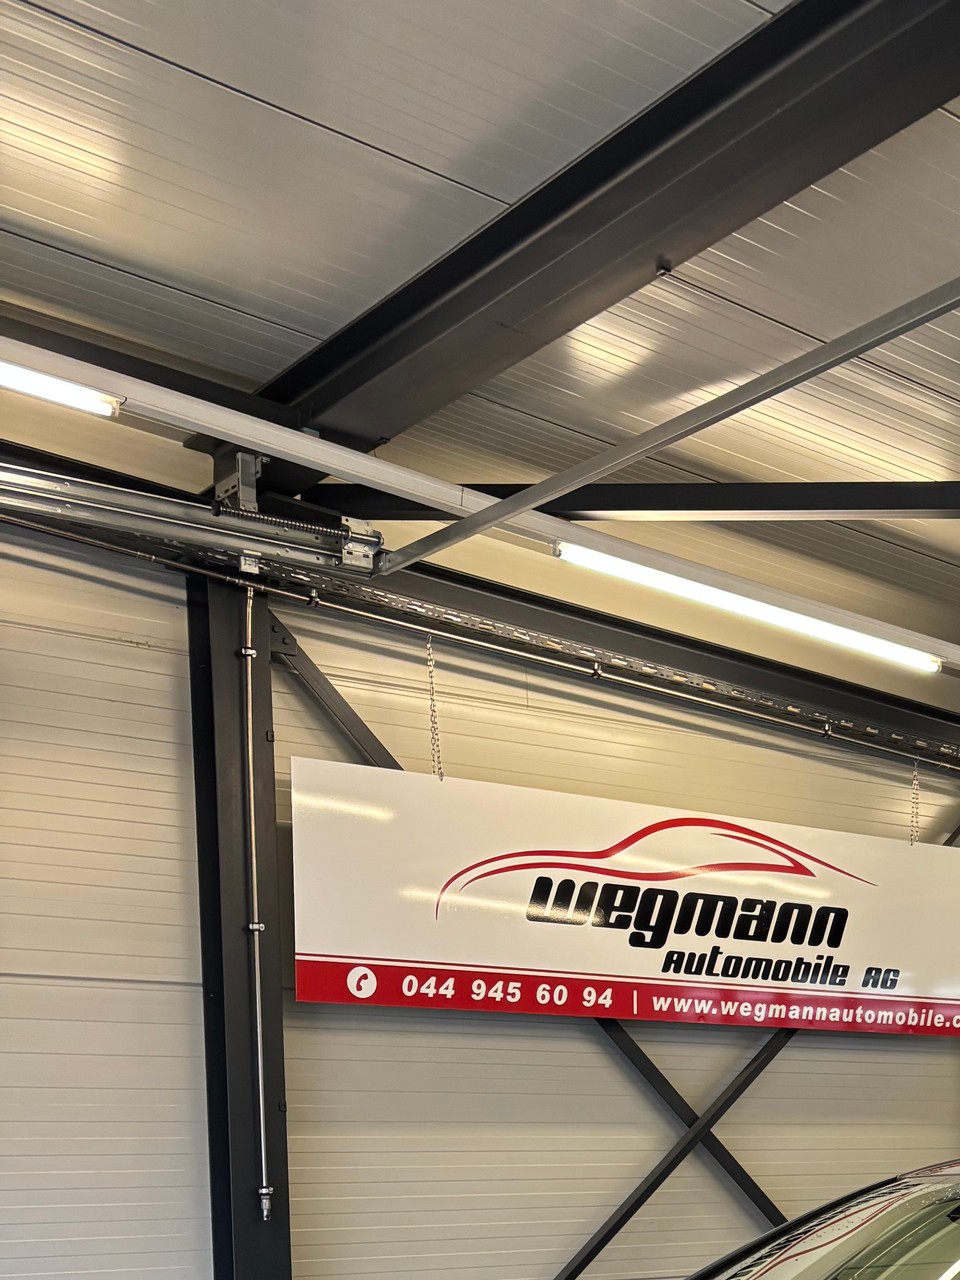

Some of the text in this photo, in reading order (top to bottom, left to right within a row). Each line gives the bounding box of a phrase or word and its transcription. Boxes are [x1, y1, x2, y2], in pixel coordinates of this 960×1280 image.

[525, 875, 849, 949] wegmann
[401, 974, 456, 999] 044
[470, 979, 522, 1003] 945
[535, 983, 569, 1005] 60
[581, 986, 613, 1008] 94
[861, 965, 901, 990] AG
